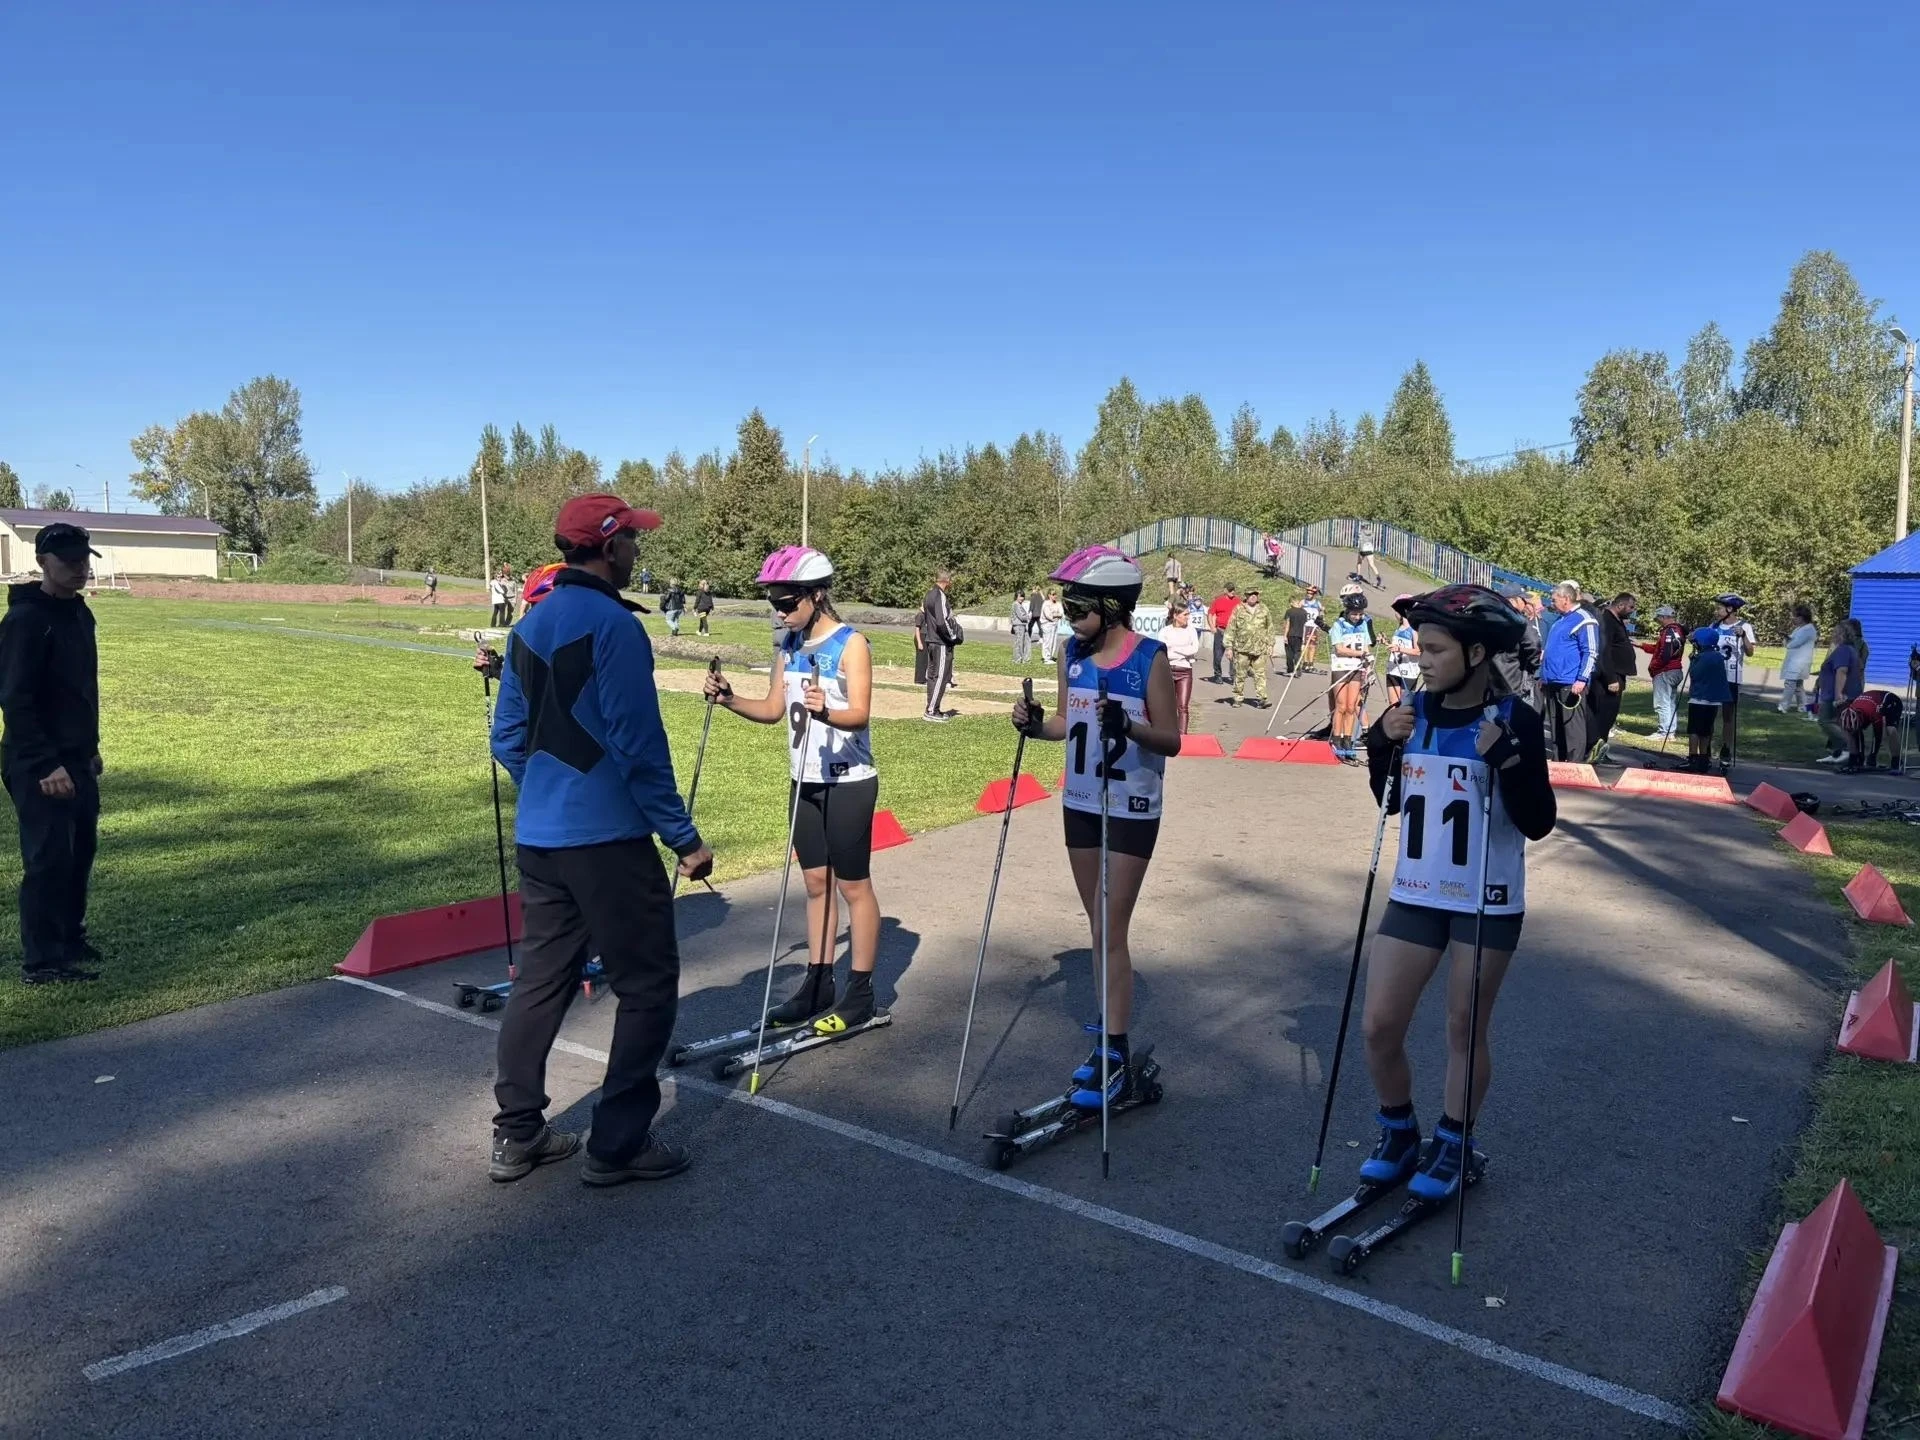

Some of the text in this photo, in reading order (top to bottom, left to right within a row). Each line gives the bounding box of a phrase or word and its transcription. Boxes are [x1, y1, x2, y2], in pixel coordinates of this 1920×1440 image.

[1192, 616, 1203, 625] 23
[789, 701, 808, 750] 9
[1068, 721, 1128, 782] 12
[1403, 794, 1470, 867] 11
